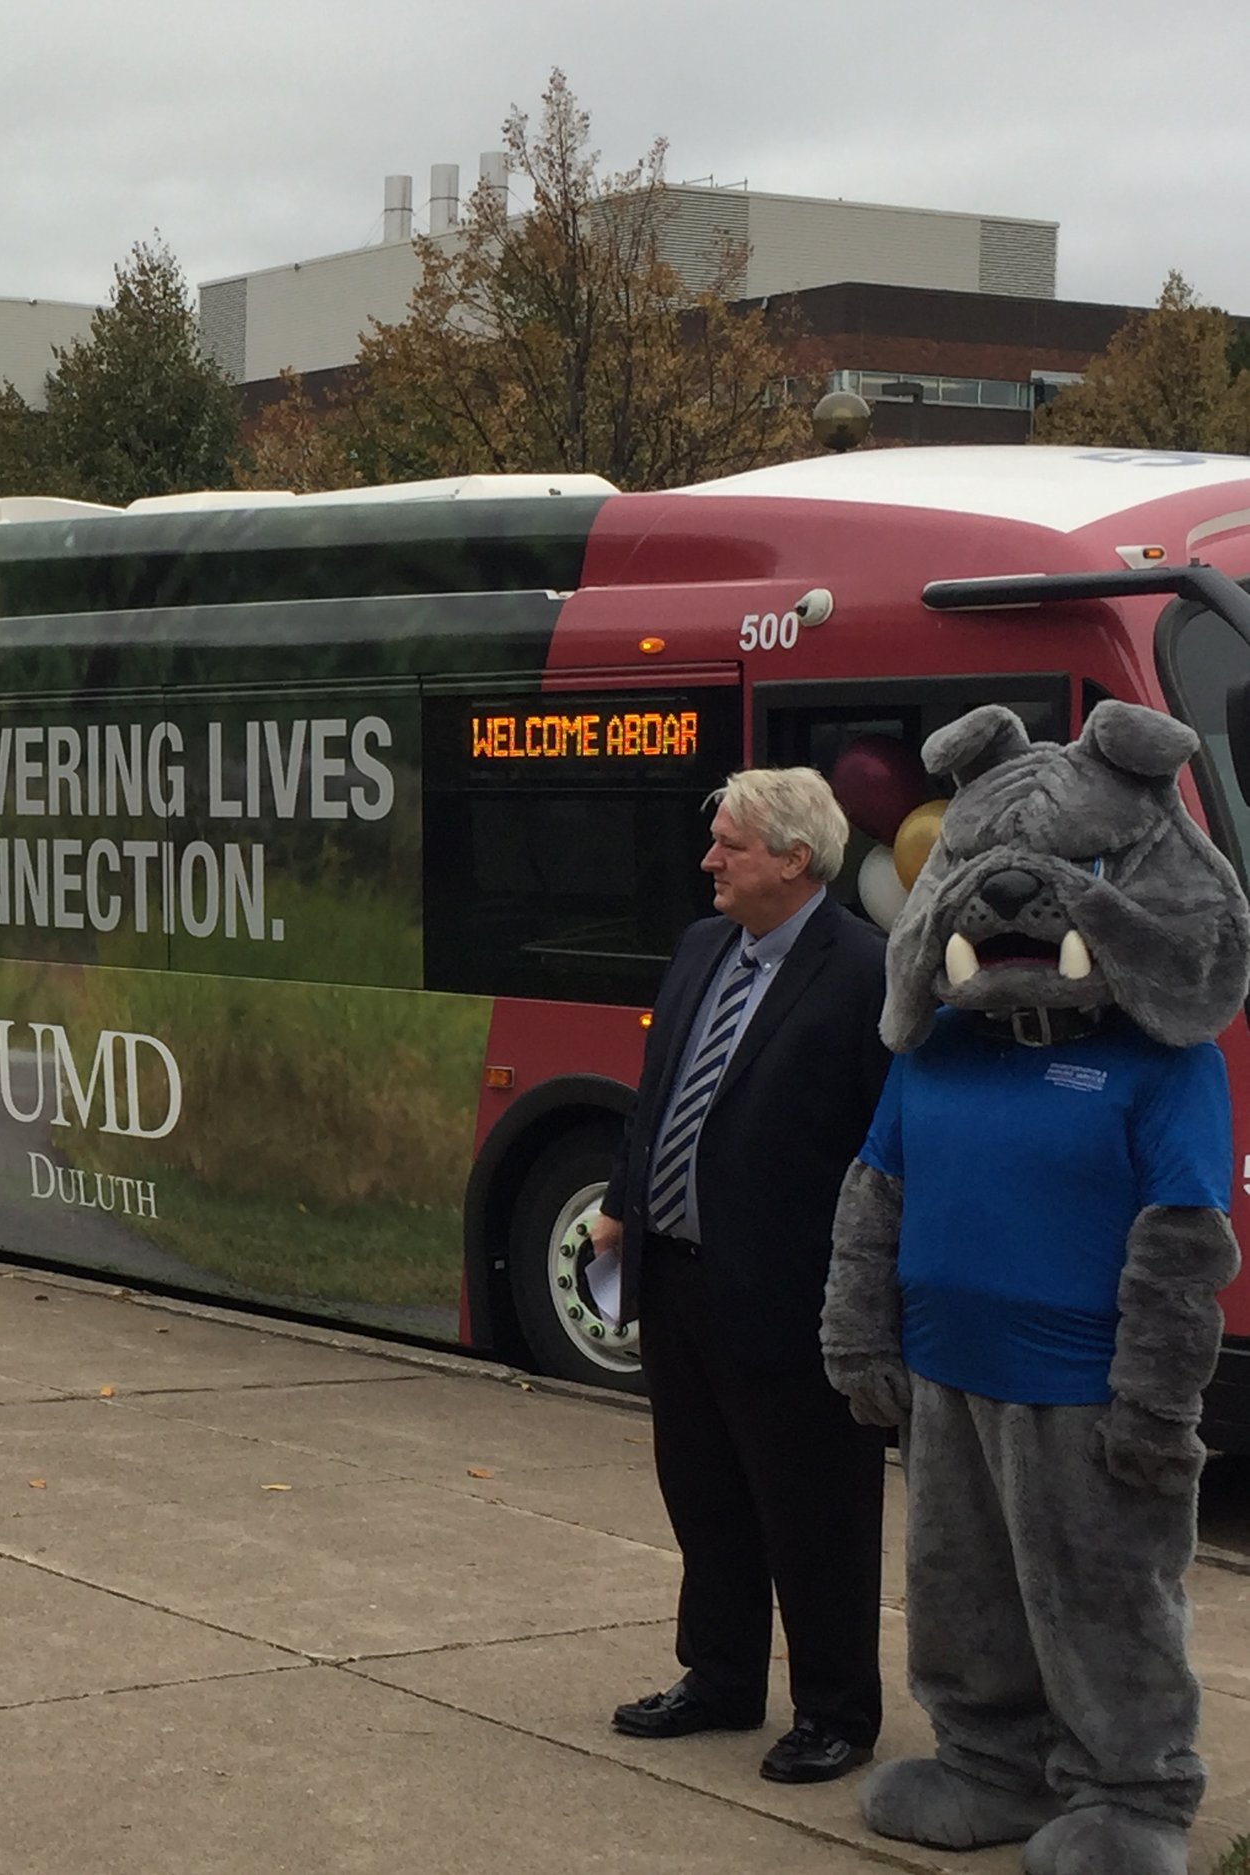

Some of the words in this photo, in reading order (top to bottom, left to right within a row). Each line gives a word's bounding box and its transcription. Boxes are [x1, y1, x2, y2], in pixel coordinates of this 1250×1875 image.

[739, 611, 799, 651] 500
[472, 715, 600, 757] WELCOME
[208, 716, 394, 821] LIVES
[27, 1152, 159, 1219] DULUTH
